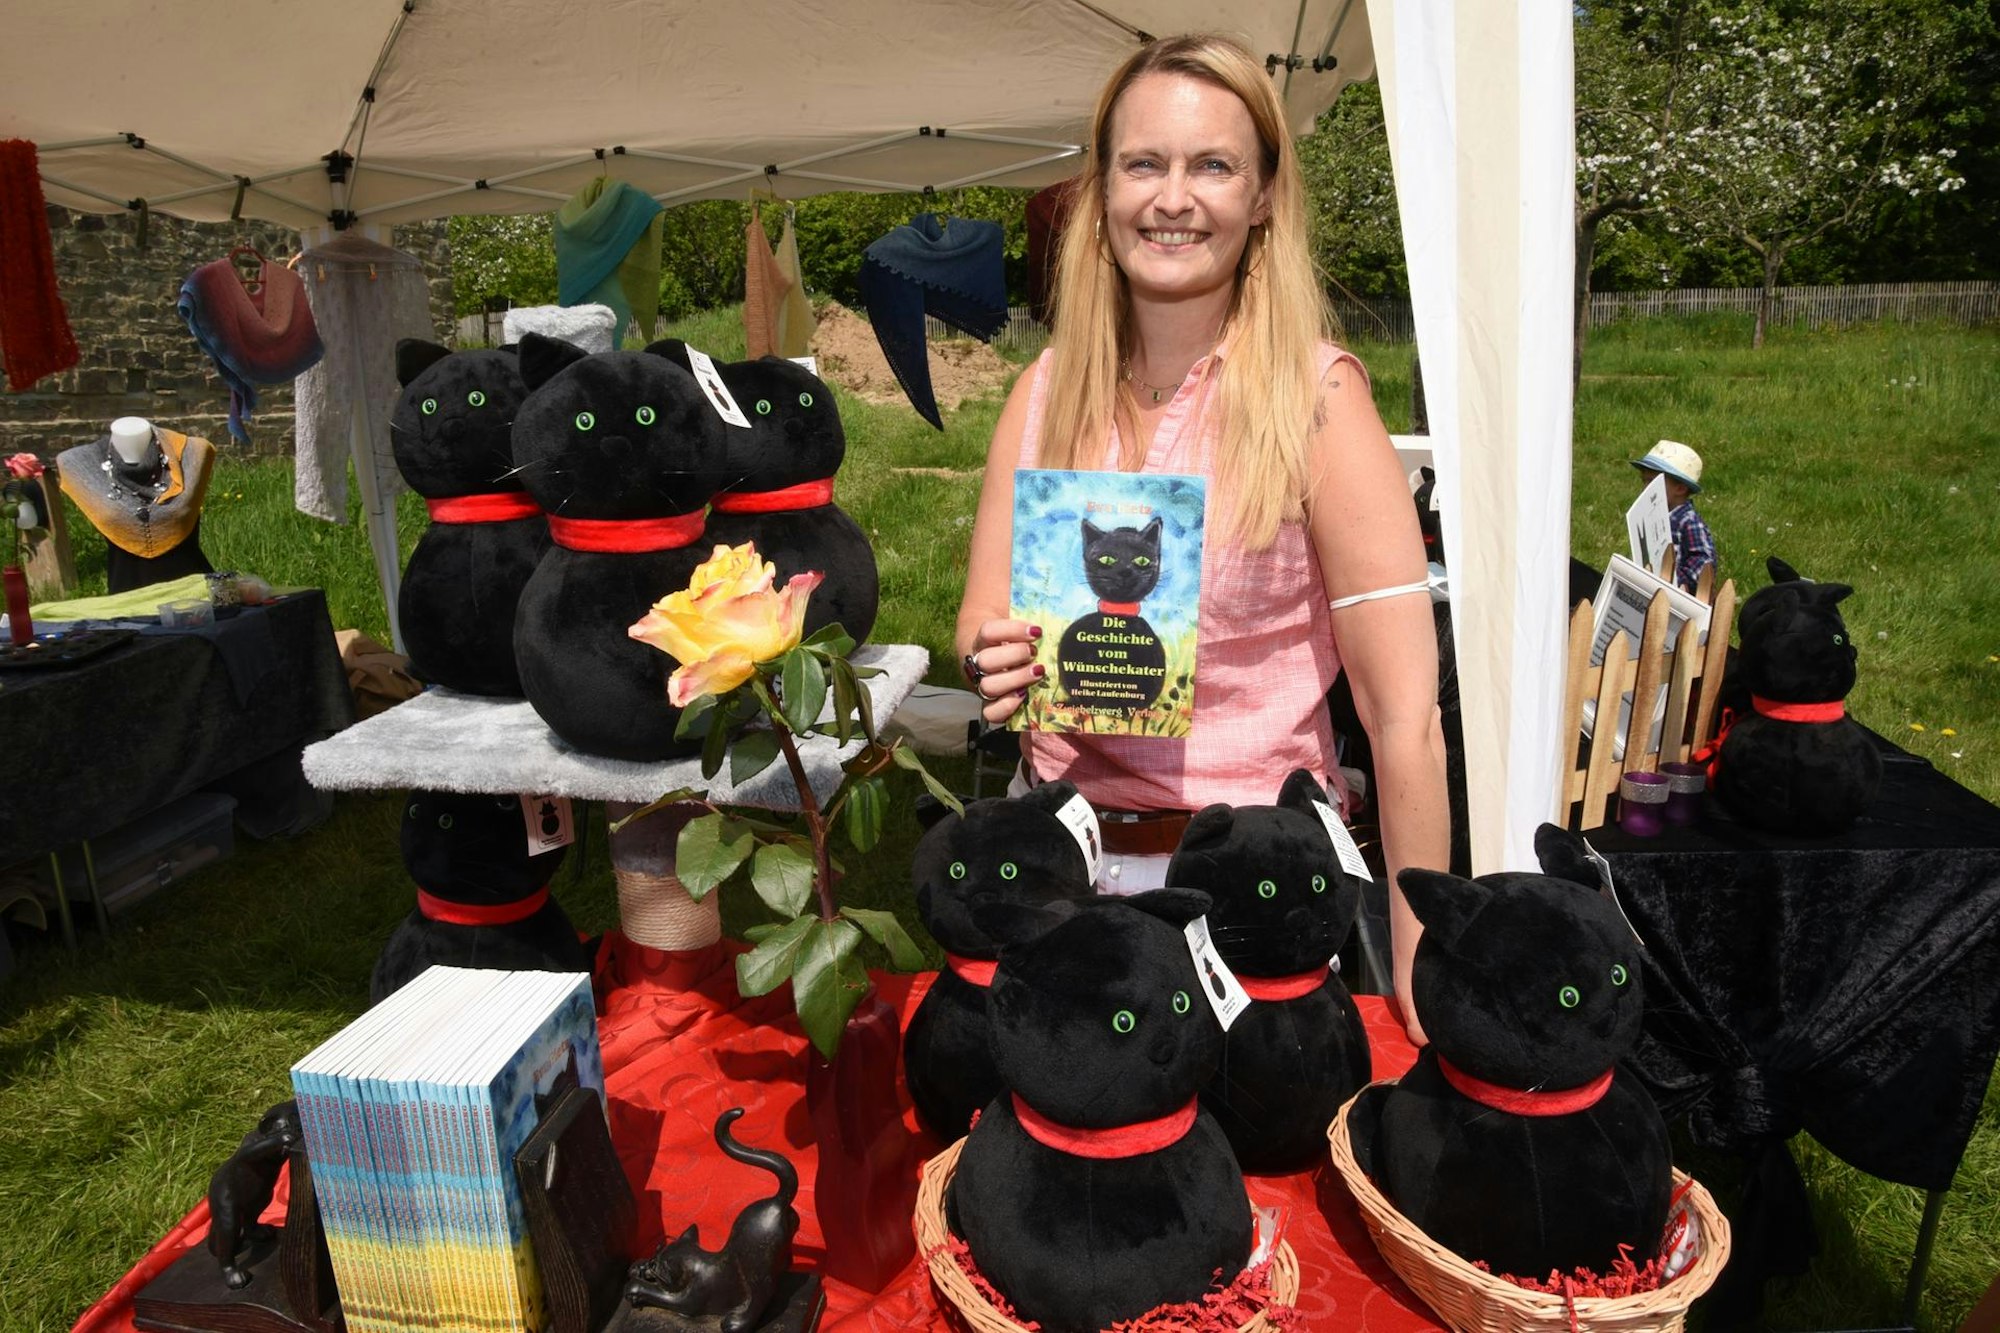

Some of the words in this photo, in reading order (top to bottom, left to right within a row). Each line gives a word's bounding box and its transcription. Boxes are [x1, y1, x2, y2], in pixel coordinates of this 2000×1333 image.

[1102, 617, 1126, 629] Die
[1076, 631, 1154, 646] Geschichte
[1097, 649, 1128, 660] vom
[1062, 661, 1165, 677] Wünschekater
[1080, 680, 1121, 689] Illustriert
[1122, 682, 1138, 690] von
[1071, 689, 1096, 697] Heike
[1096, 690, 1146, 700] Laufenburg
